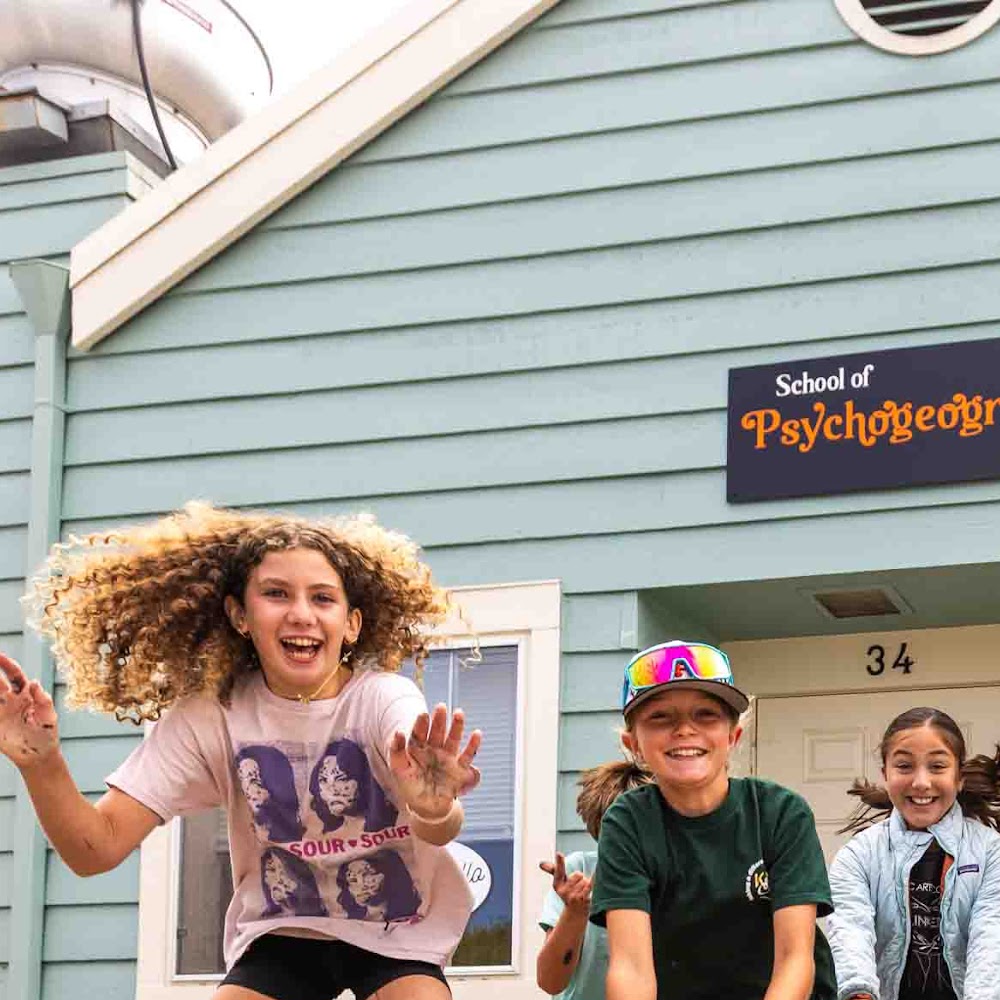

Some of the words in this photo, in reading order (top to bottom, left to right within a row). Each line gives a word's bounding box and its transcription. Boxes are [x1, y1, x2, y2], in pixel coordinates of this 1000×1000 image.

[775, 367, 845, 397] School
[850, 364, 875, 389] of
[866, 642, 915, 676] 34
[289, 838, 346, 857] SOUR
[361, 825, 411, 848] SOUR
